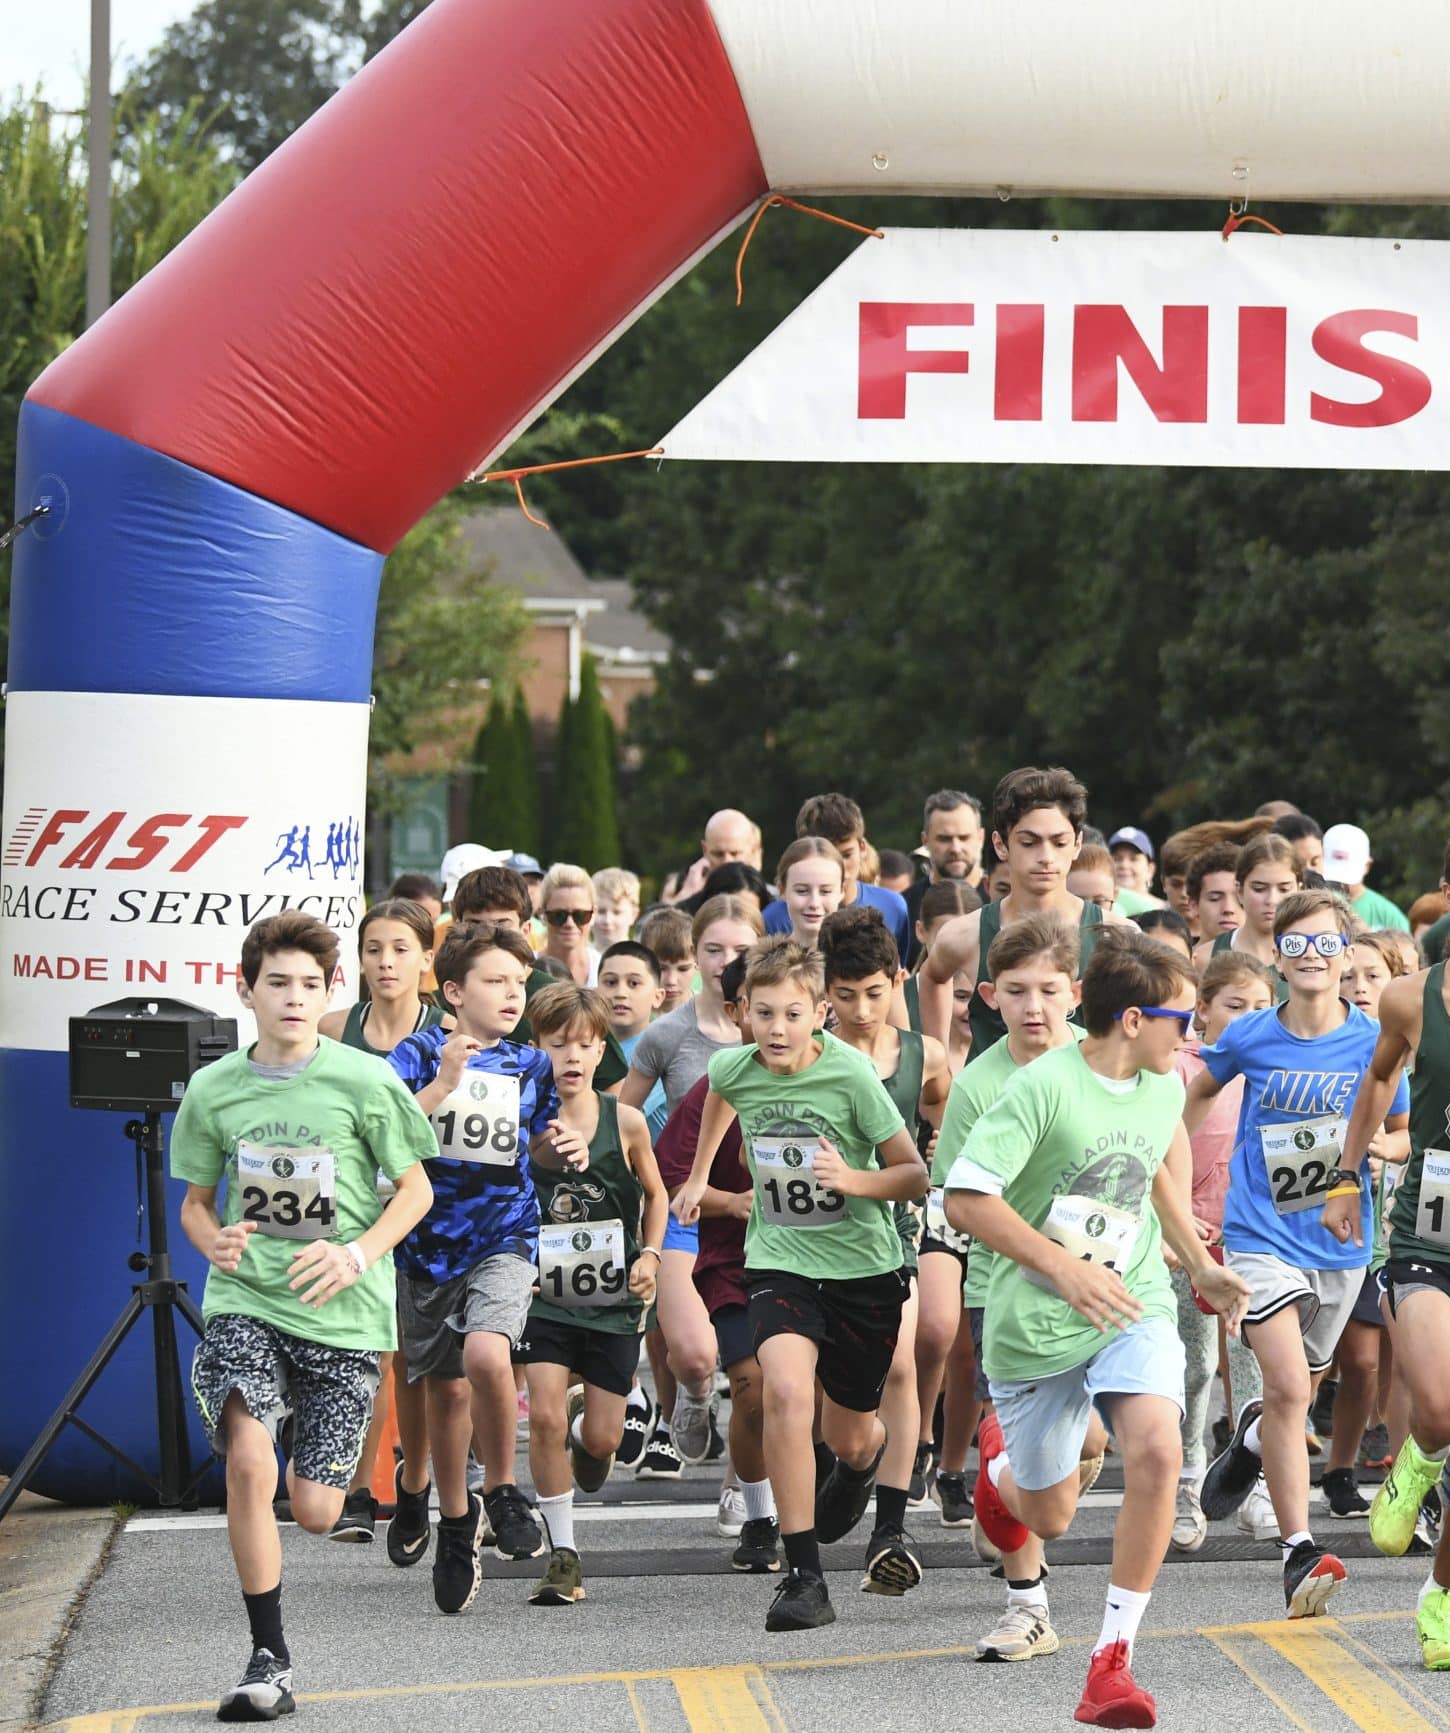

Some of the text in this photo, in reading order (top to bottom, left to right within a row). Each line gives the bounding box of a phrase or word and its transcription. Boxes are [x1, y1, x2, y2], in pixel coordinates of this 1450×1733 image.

[24, 809, 250, 873] FAST
[1, 884, 97, 921] RACE
[14, 953, 242, 986] MADE IN TH
[1260, 1069, 1359, 1114] NIKE
[437, 1110, 517, 1153] 198
[764, 1178, 845, 1215] 183
[1271, 1153, 1341, 1203] 22
[242, 1185, 335, 1227] 234
[545, 1260, 625, 1298] 169
